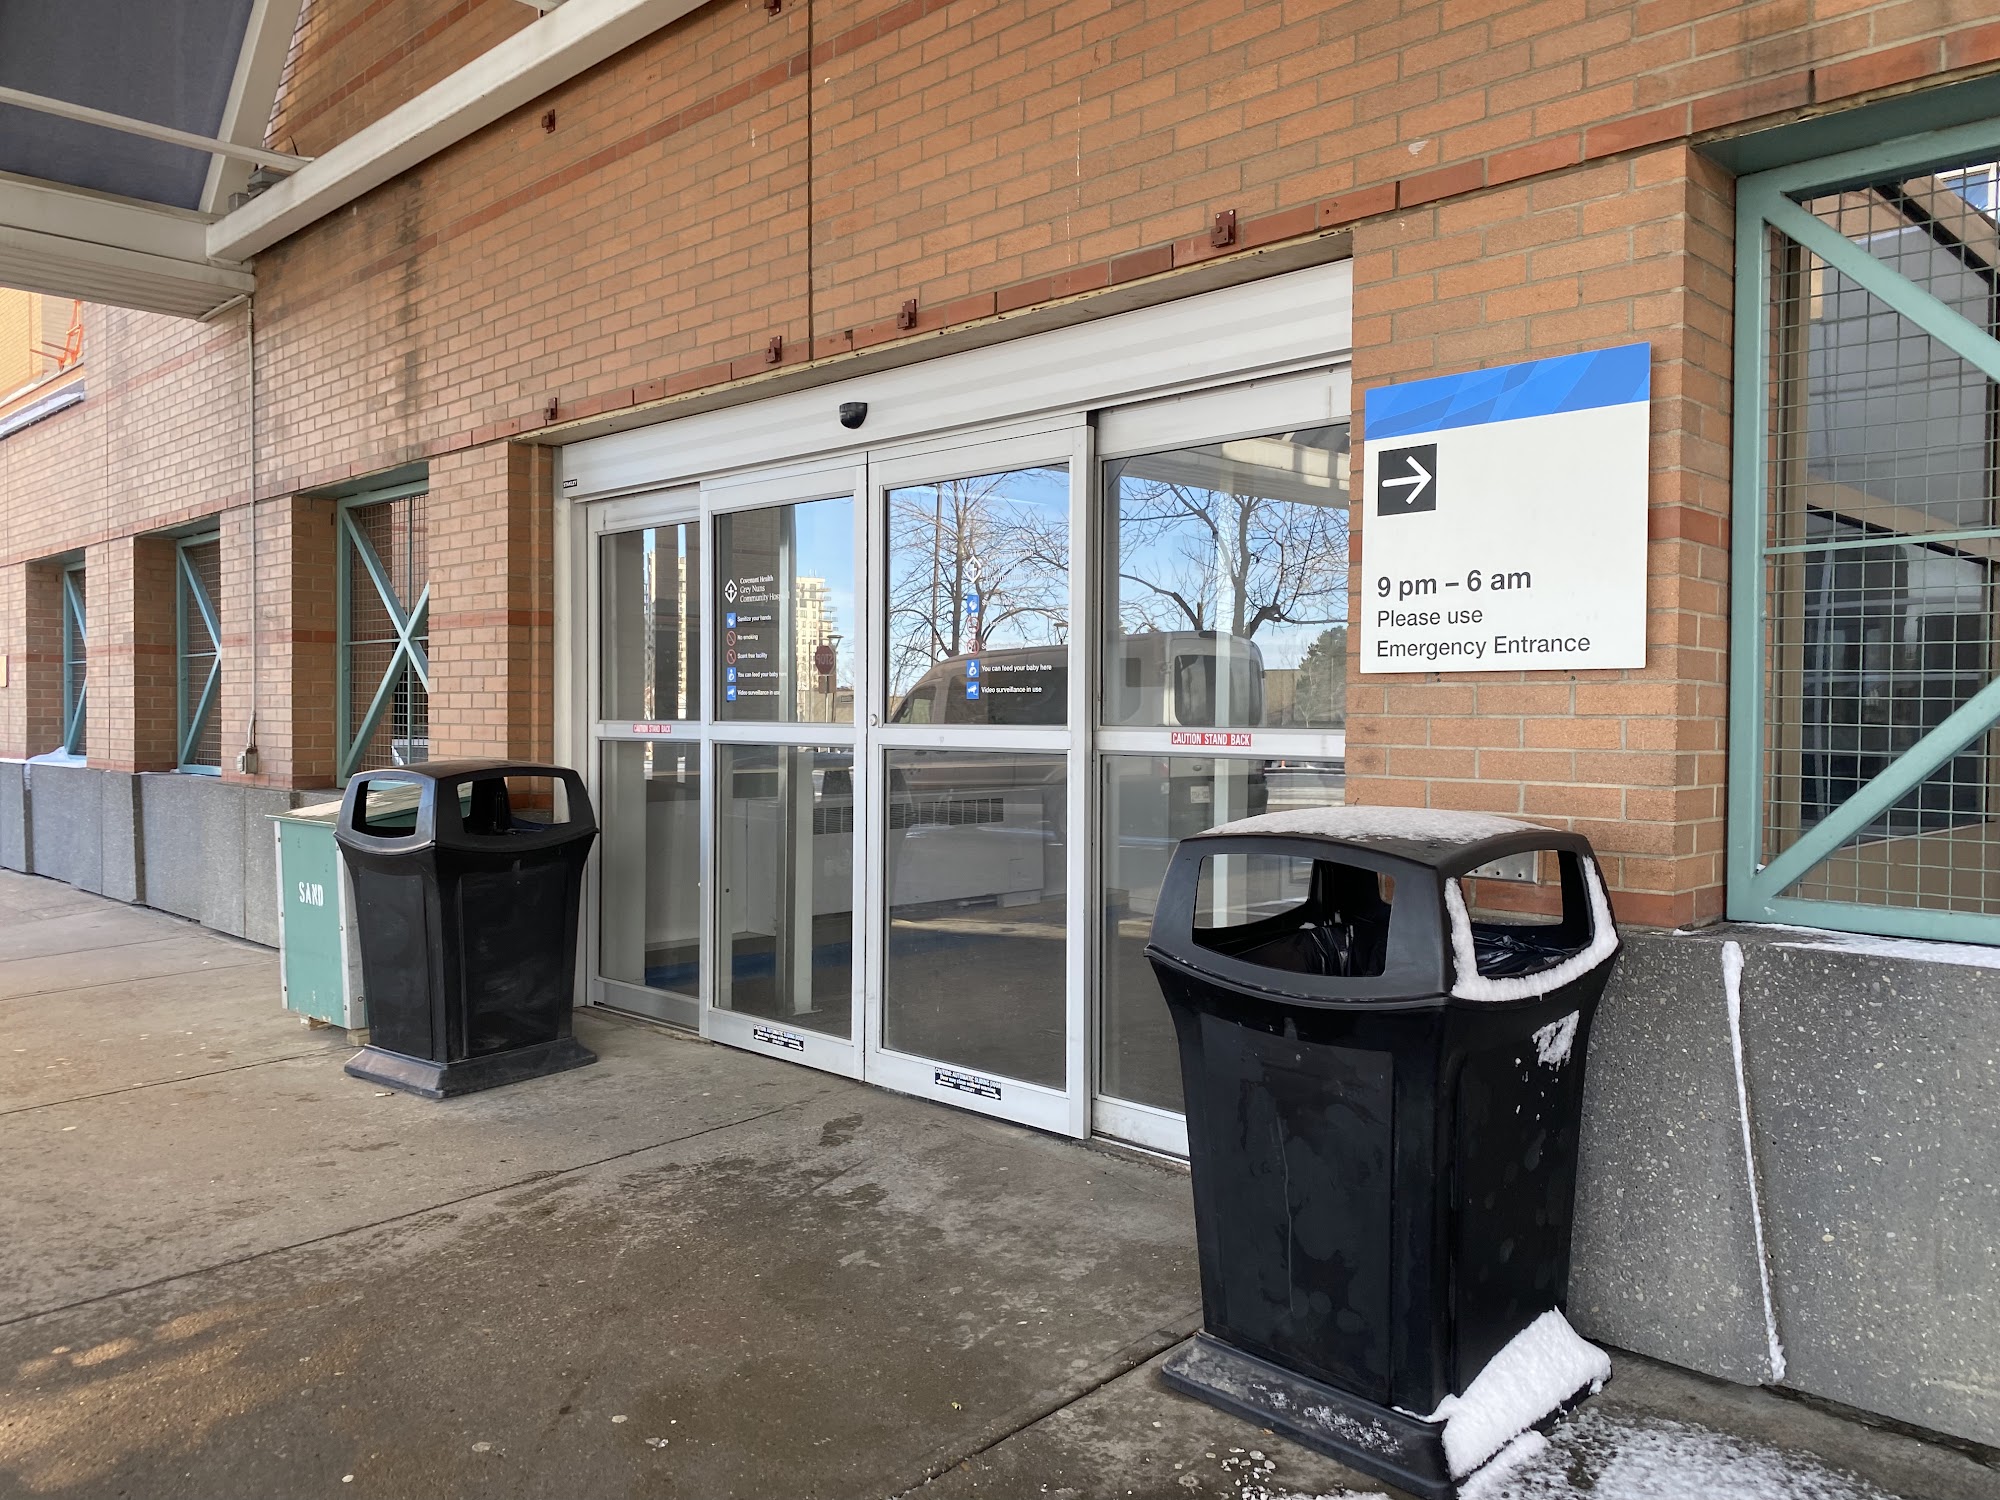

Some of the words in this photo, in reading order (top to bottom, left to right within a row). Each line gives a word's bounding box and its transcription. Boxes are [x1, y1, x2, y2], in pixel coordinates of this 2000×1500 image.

[740, 576, 760, 585] Covenant
[760, 574, 774, 583] Health
[1377, 576, 1391, 598] 9
[1399, 577, 1437, 601] pm
[1467, 569, 1482, 592] 6
[1490, 570, 1532, 591] am
[740, 585, 751, 594] Grey
[752, 584, 766, 593] Nuns
[740, 592, 769, 603] Community
[1377, 610, 1441, 628] Please
[1447, 609, 1483, 624] use
[743, 633, 759, 641] smoking
[1377, 640, 1487, 661] Emergency
[1494, 636, 1591, 654] Entrance
[756, 652, 768, 660] facility
[981, 665, 992, 673] You
[1013, 664, 1026, 673] your
[1026, 663, 1040, 672] baby
[1040, 663, 1053, 671] here
[760, 671, 769, 679] your
[769, 671, 779, 679] baby
[981, 685, 995, 693] Video
[995, 684, 1026, 693] surveillance
[1032, 685, 1043, 693] use
[1172, 732, 1202, 745] CAUTION
[1204, 733, 1228, 745] STAND
[1230, 734, 1250, 746] BACK
[298, 881, 324, 907] SAND
